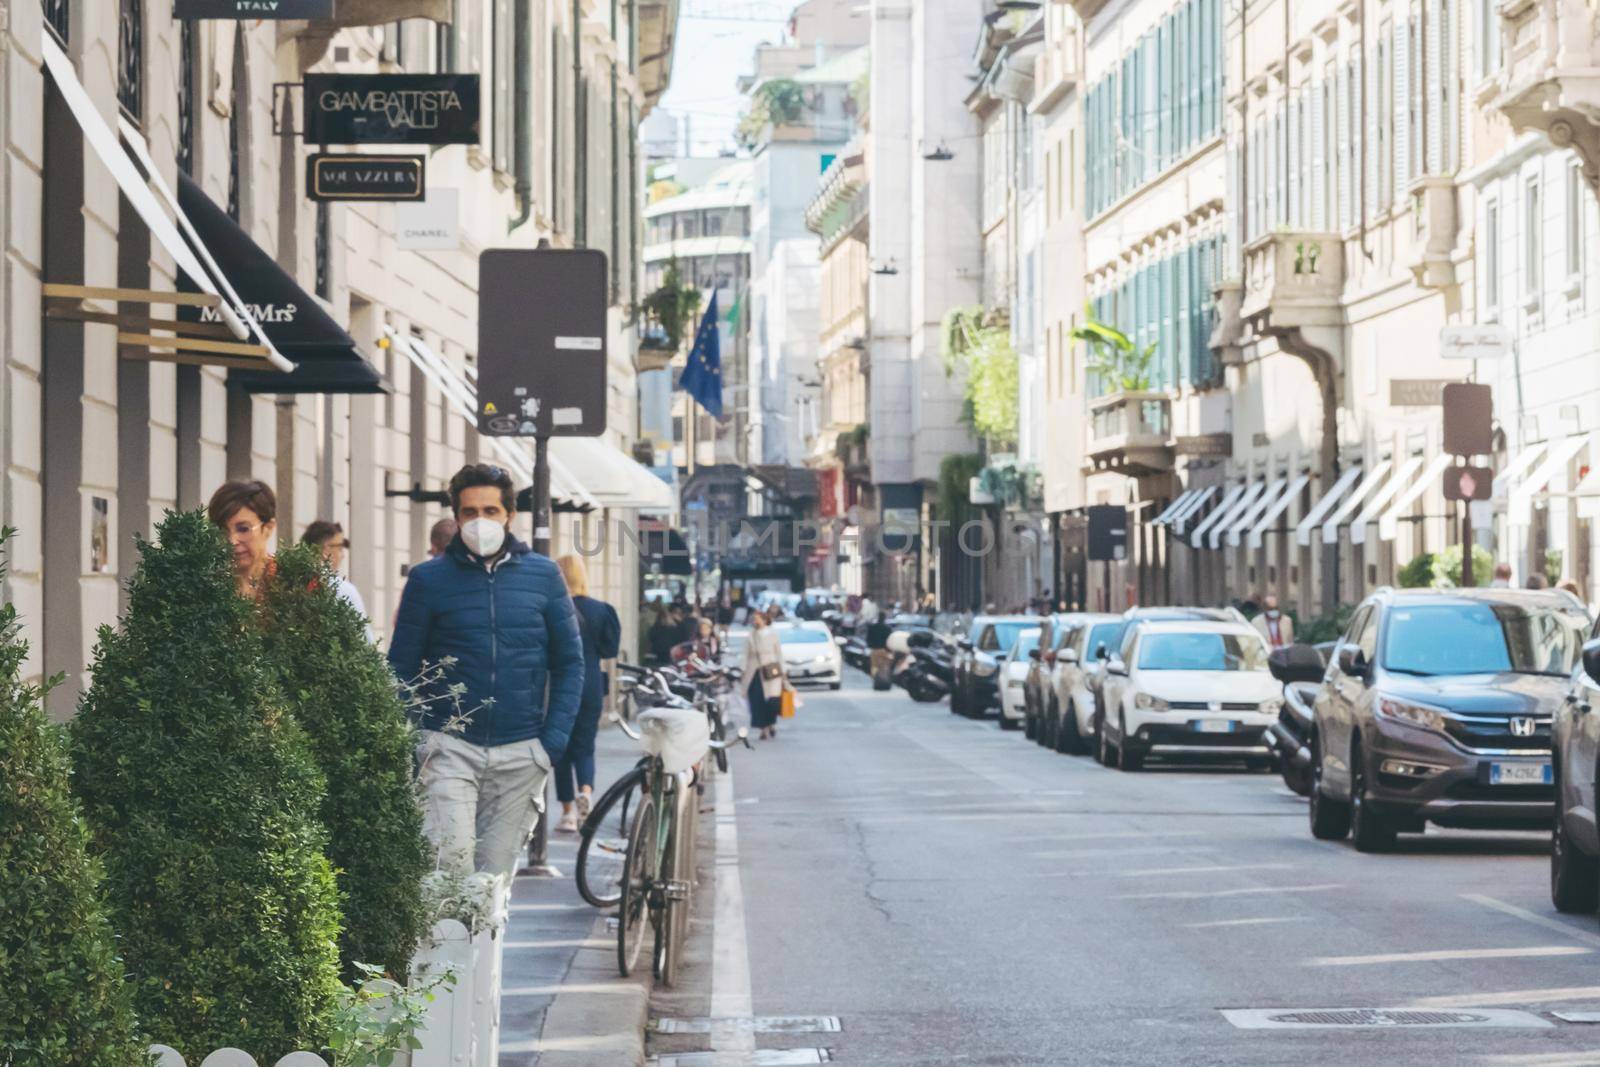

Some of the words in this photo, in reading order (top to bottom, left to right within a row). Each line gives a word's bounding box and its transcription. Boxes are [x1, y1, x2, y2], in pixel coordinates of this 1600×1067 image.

[236, 1, 278, 11] ITALY
[385, 104, 439, 129] VALLI
[403, 229, 449, 238] CHANEL
